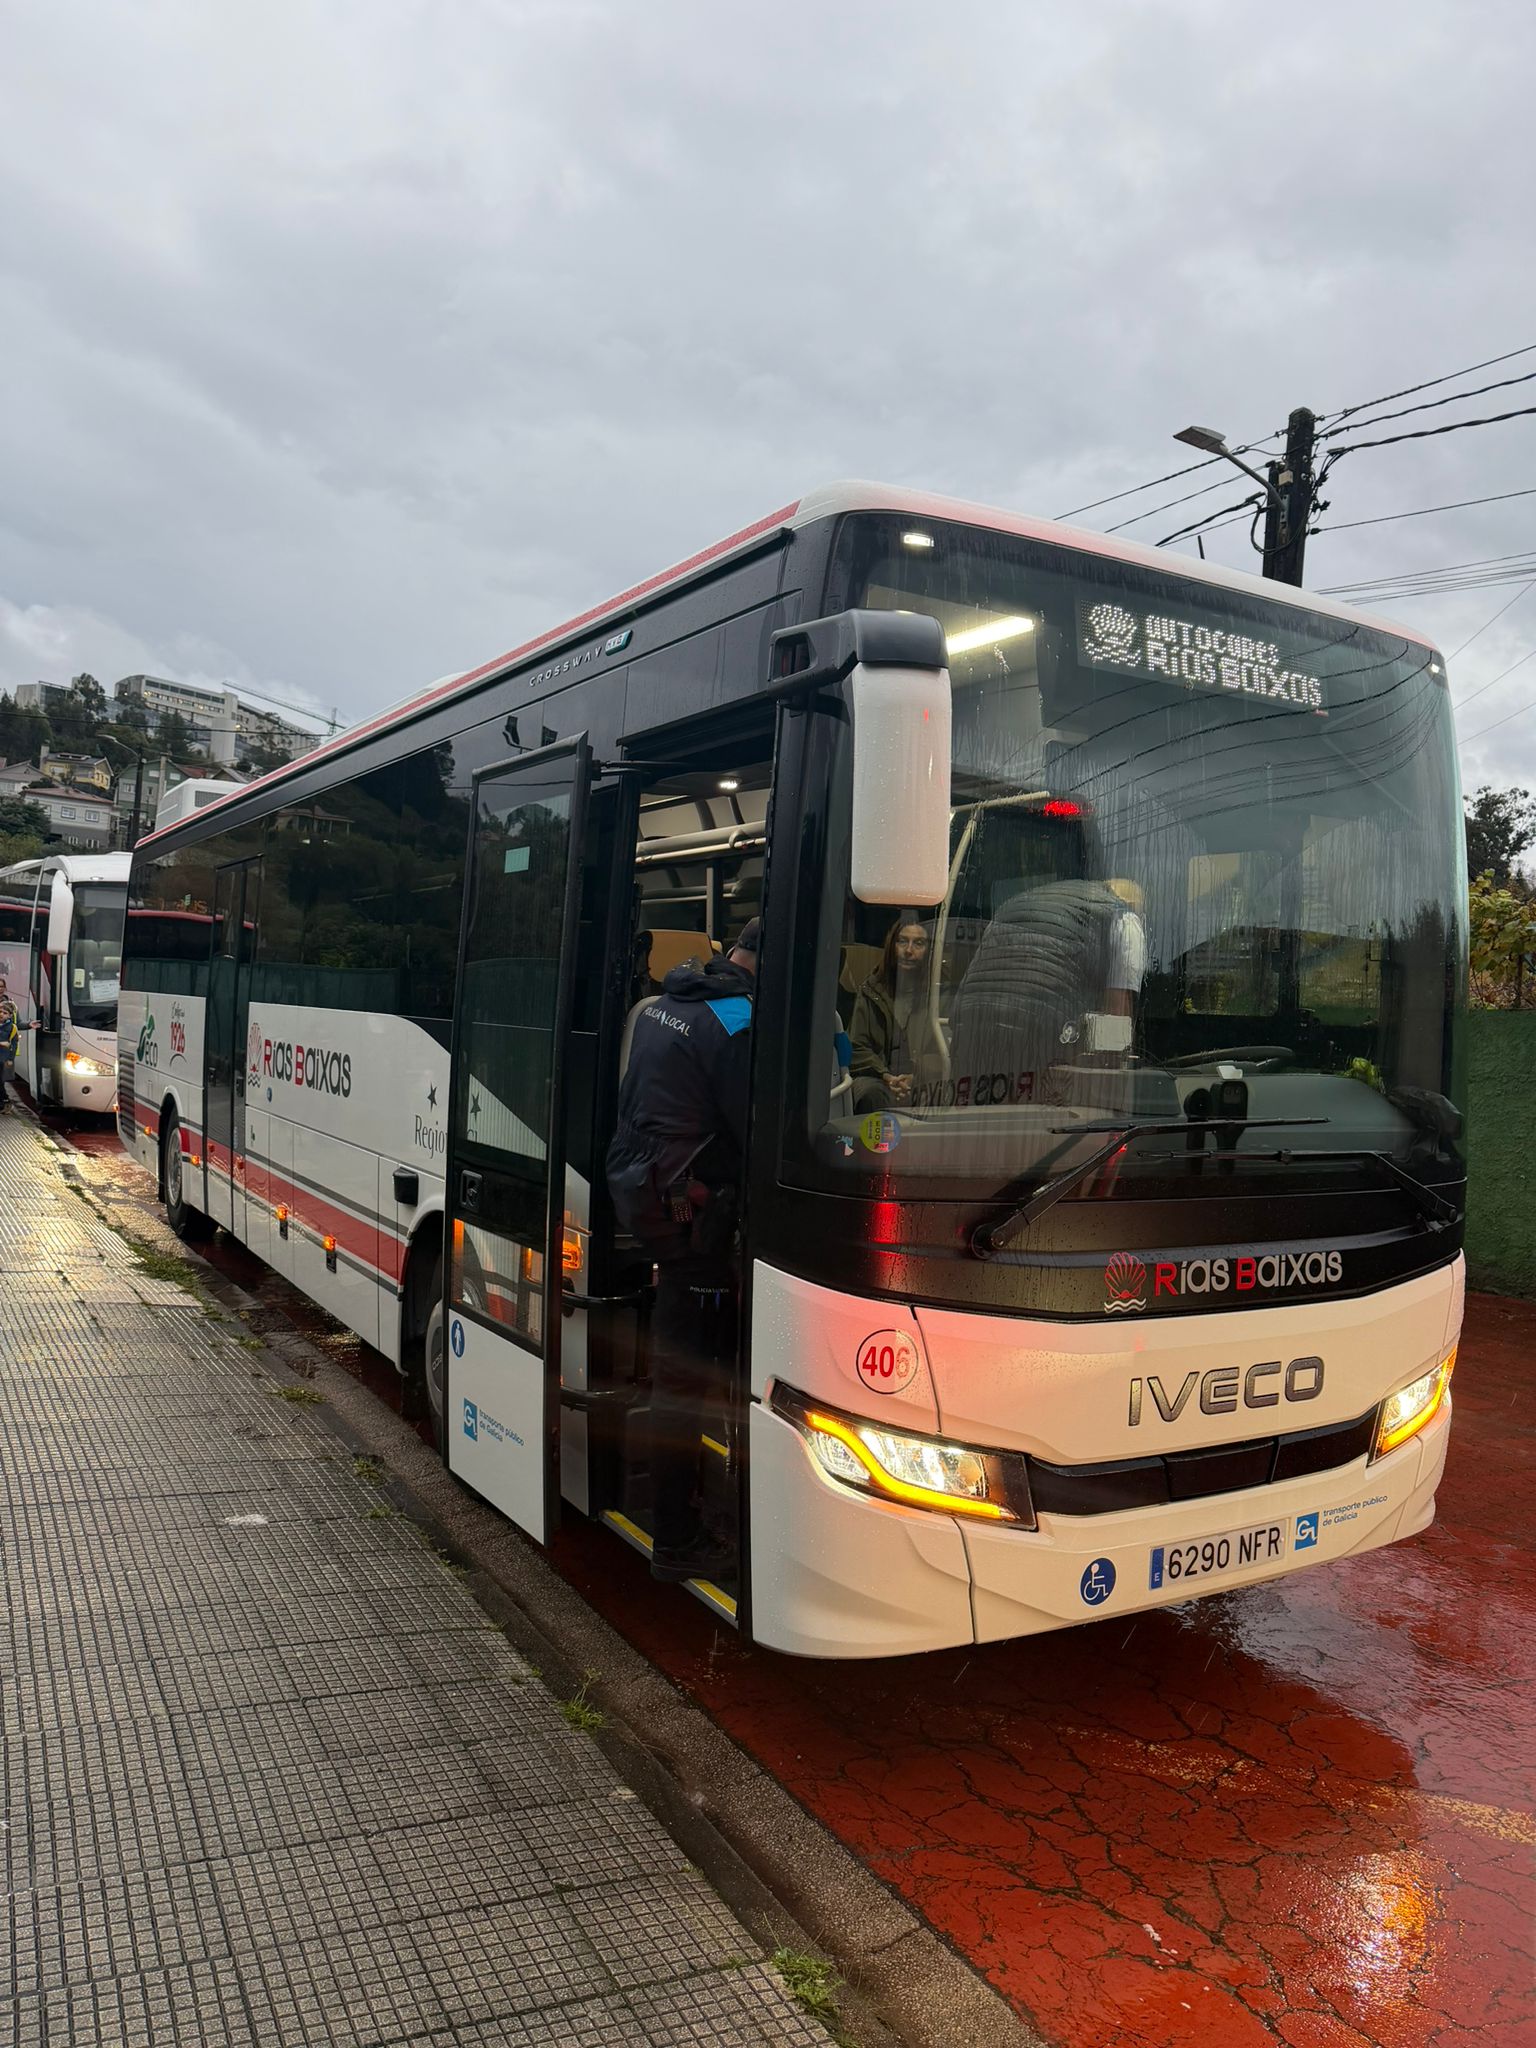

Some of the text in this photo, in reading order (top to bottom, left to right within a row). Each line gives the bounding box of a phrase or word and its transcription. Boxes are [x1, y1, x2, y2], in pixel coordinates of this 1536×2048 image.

[529, 646, 602, 687] CROSSWAY
[664, 1014, 690, 1037] LOCAL
[295, 1045, 351, 1098] Baixas
[1236, 1250, 1343, 1291] Baixas
[862, 1346, 910, 1378] 406
[1128, 1356, 1325, 1427] IVECO
[1322, 1511, 1358, 1527] de Galicia
[1323, 1501, 1361, 1516] transporte
[1168, 1526, 1281, 1580] 6290 NFR
[1154, 1571, 1161, 1582] E
